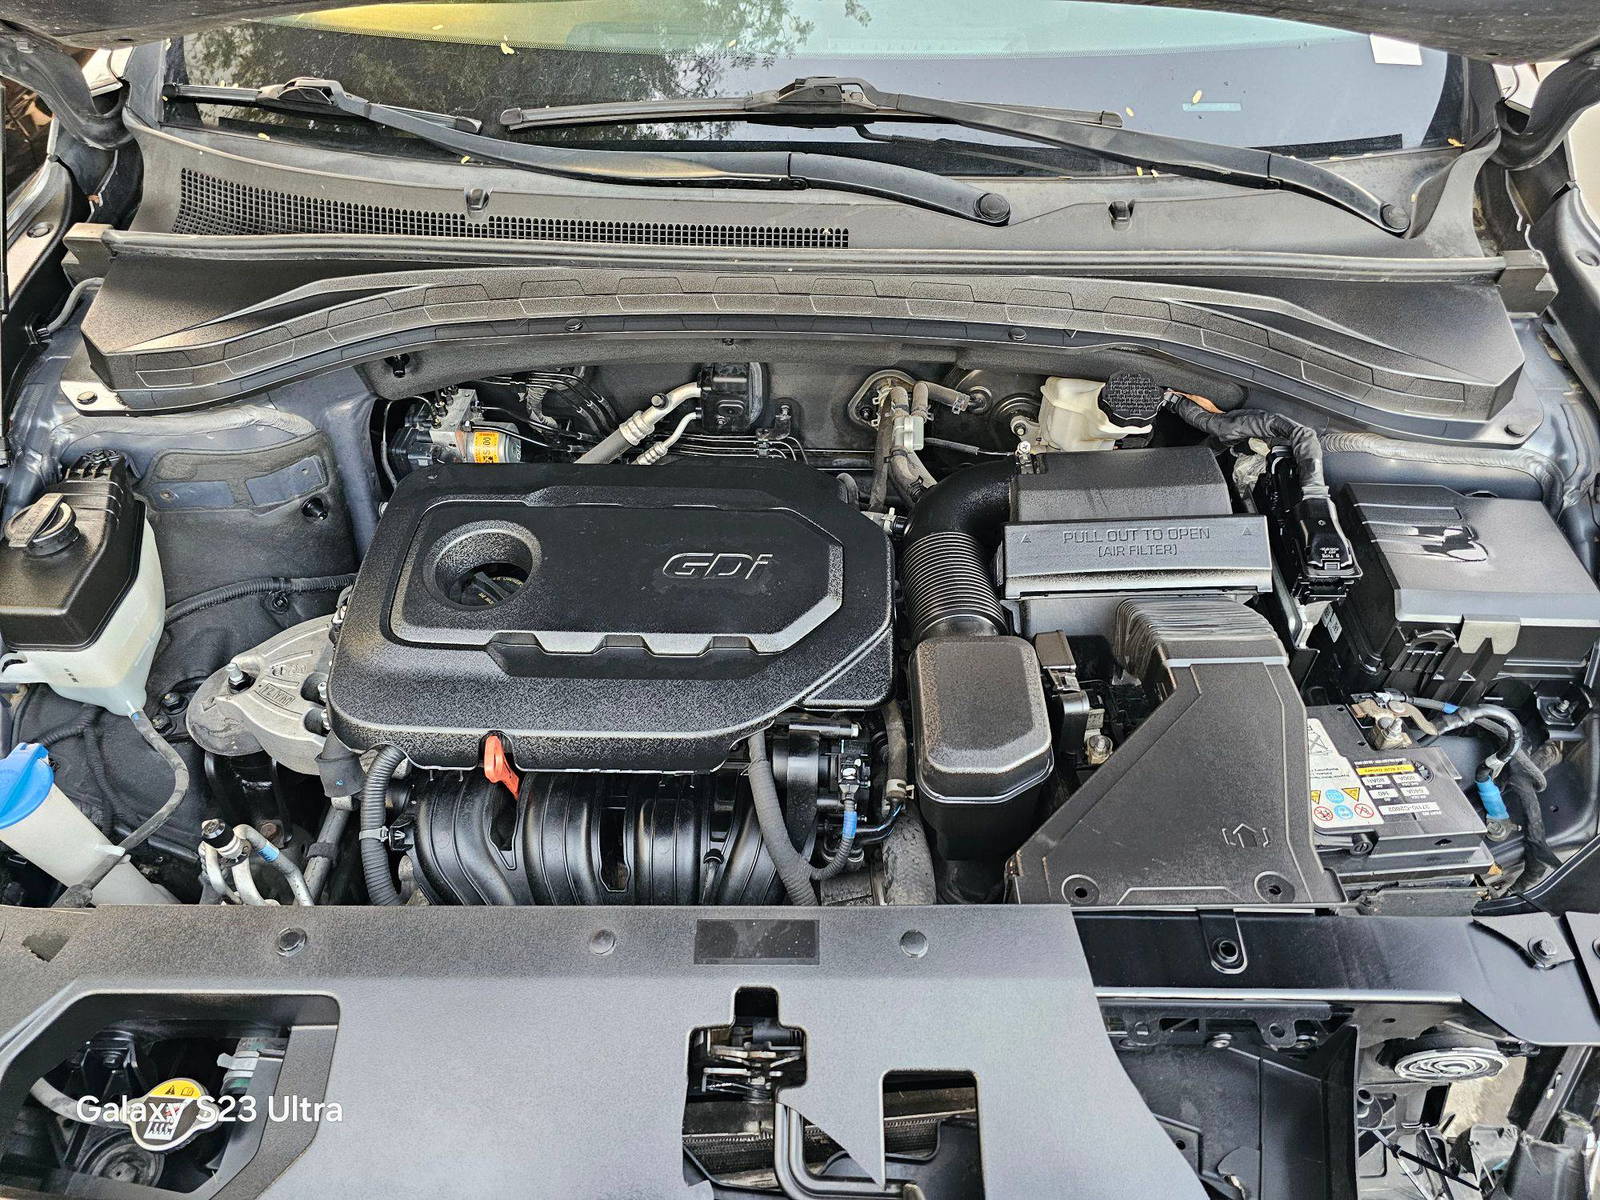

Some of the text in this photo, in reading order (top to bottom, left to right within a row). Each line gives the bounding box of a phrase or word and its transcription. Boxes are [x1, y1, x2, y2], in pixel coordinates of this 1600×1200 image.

[1062, 527, 1210, 544] PULL OUT TO OPEN
